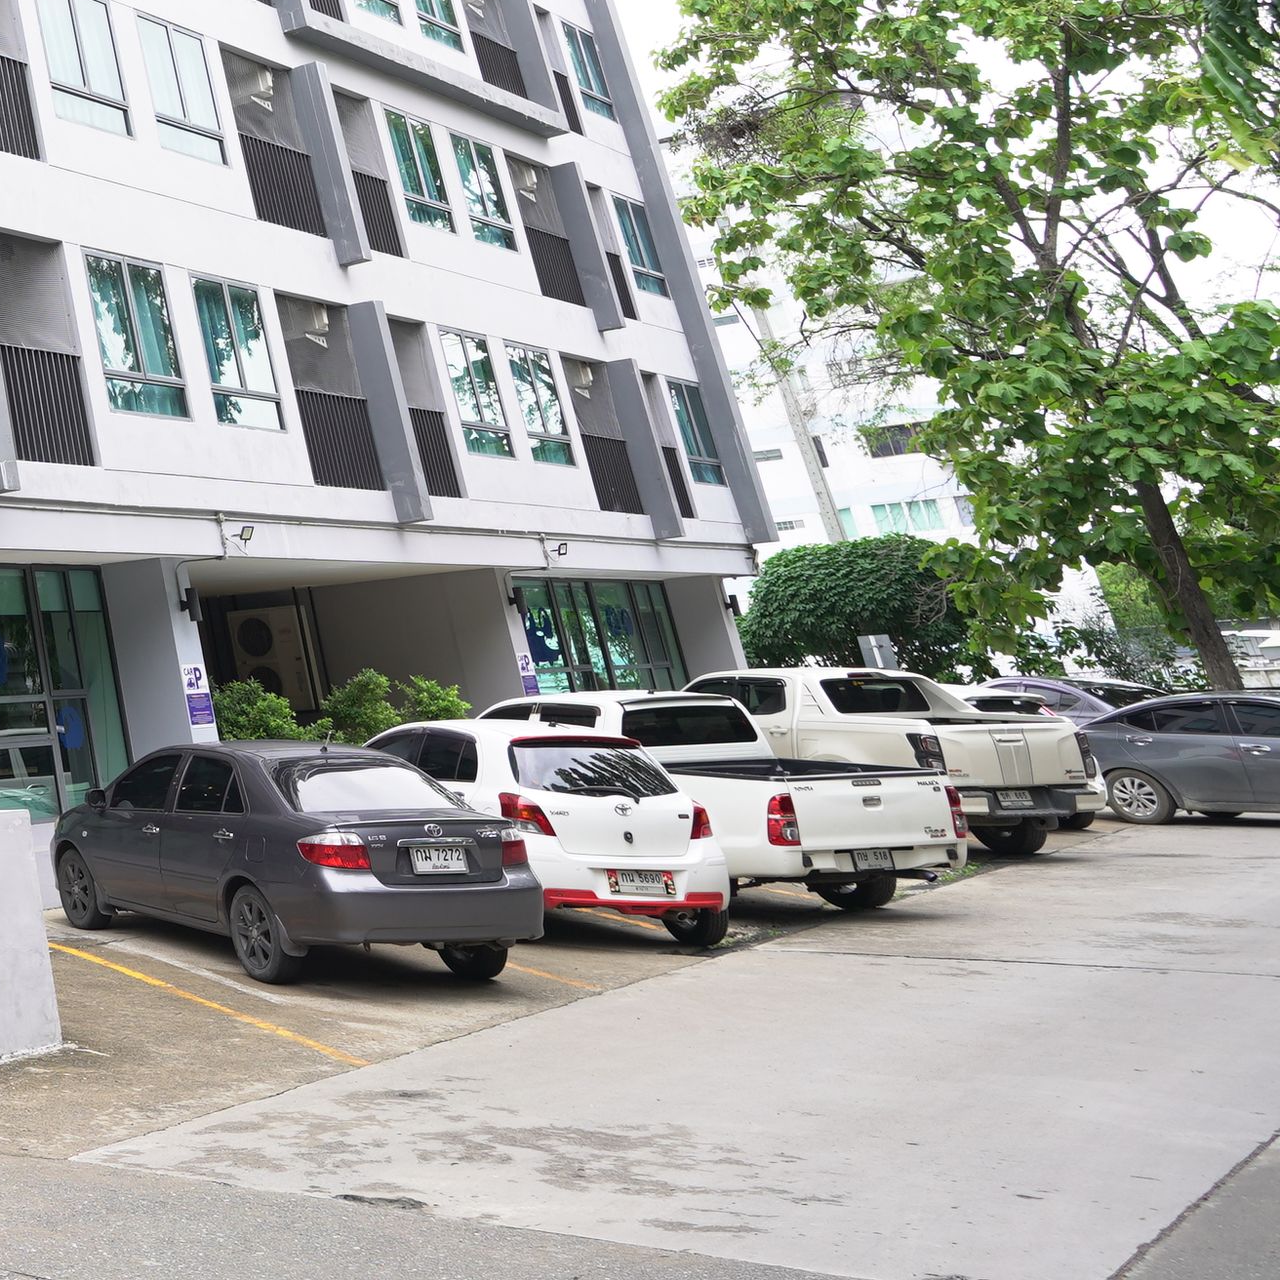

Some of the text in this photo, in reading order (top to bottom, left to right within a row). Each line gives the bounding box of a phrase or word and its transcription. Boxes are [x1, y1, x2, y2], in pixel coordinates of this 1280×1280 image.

[193, 667, 202, 689] P
[434, 848, 462, 861] 7272
[638, 873, 661, 884] 5690
